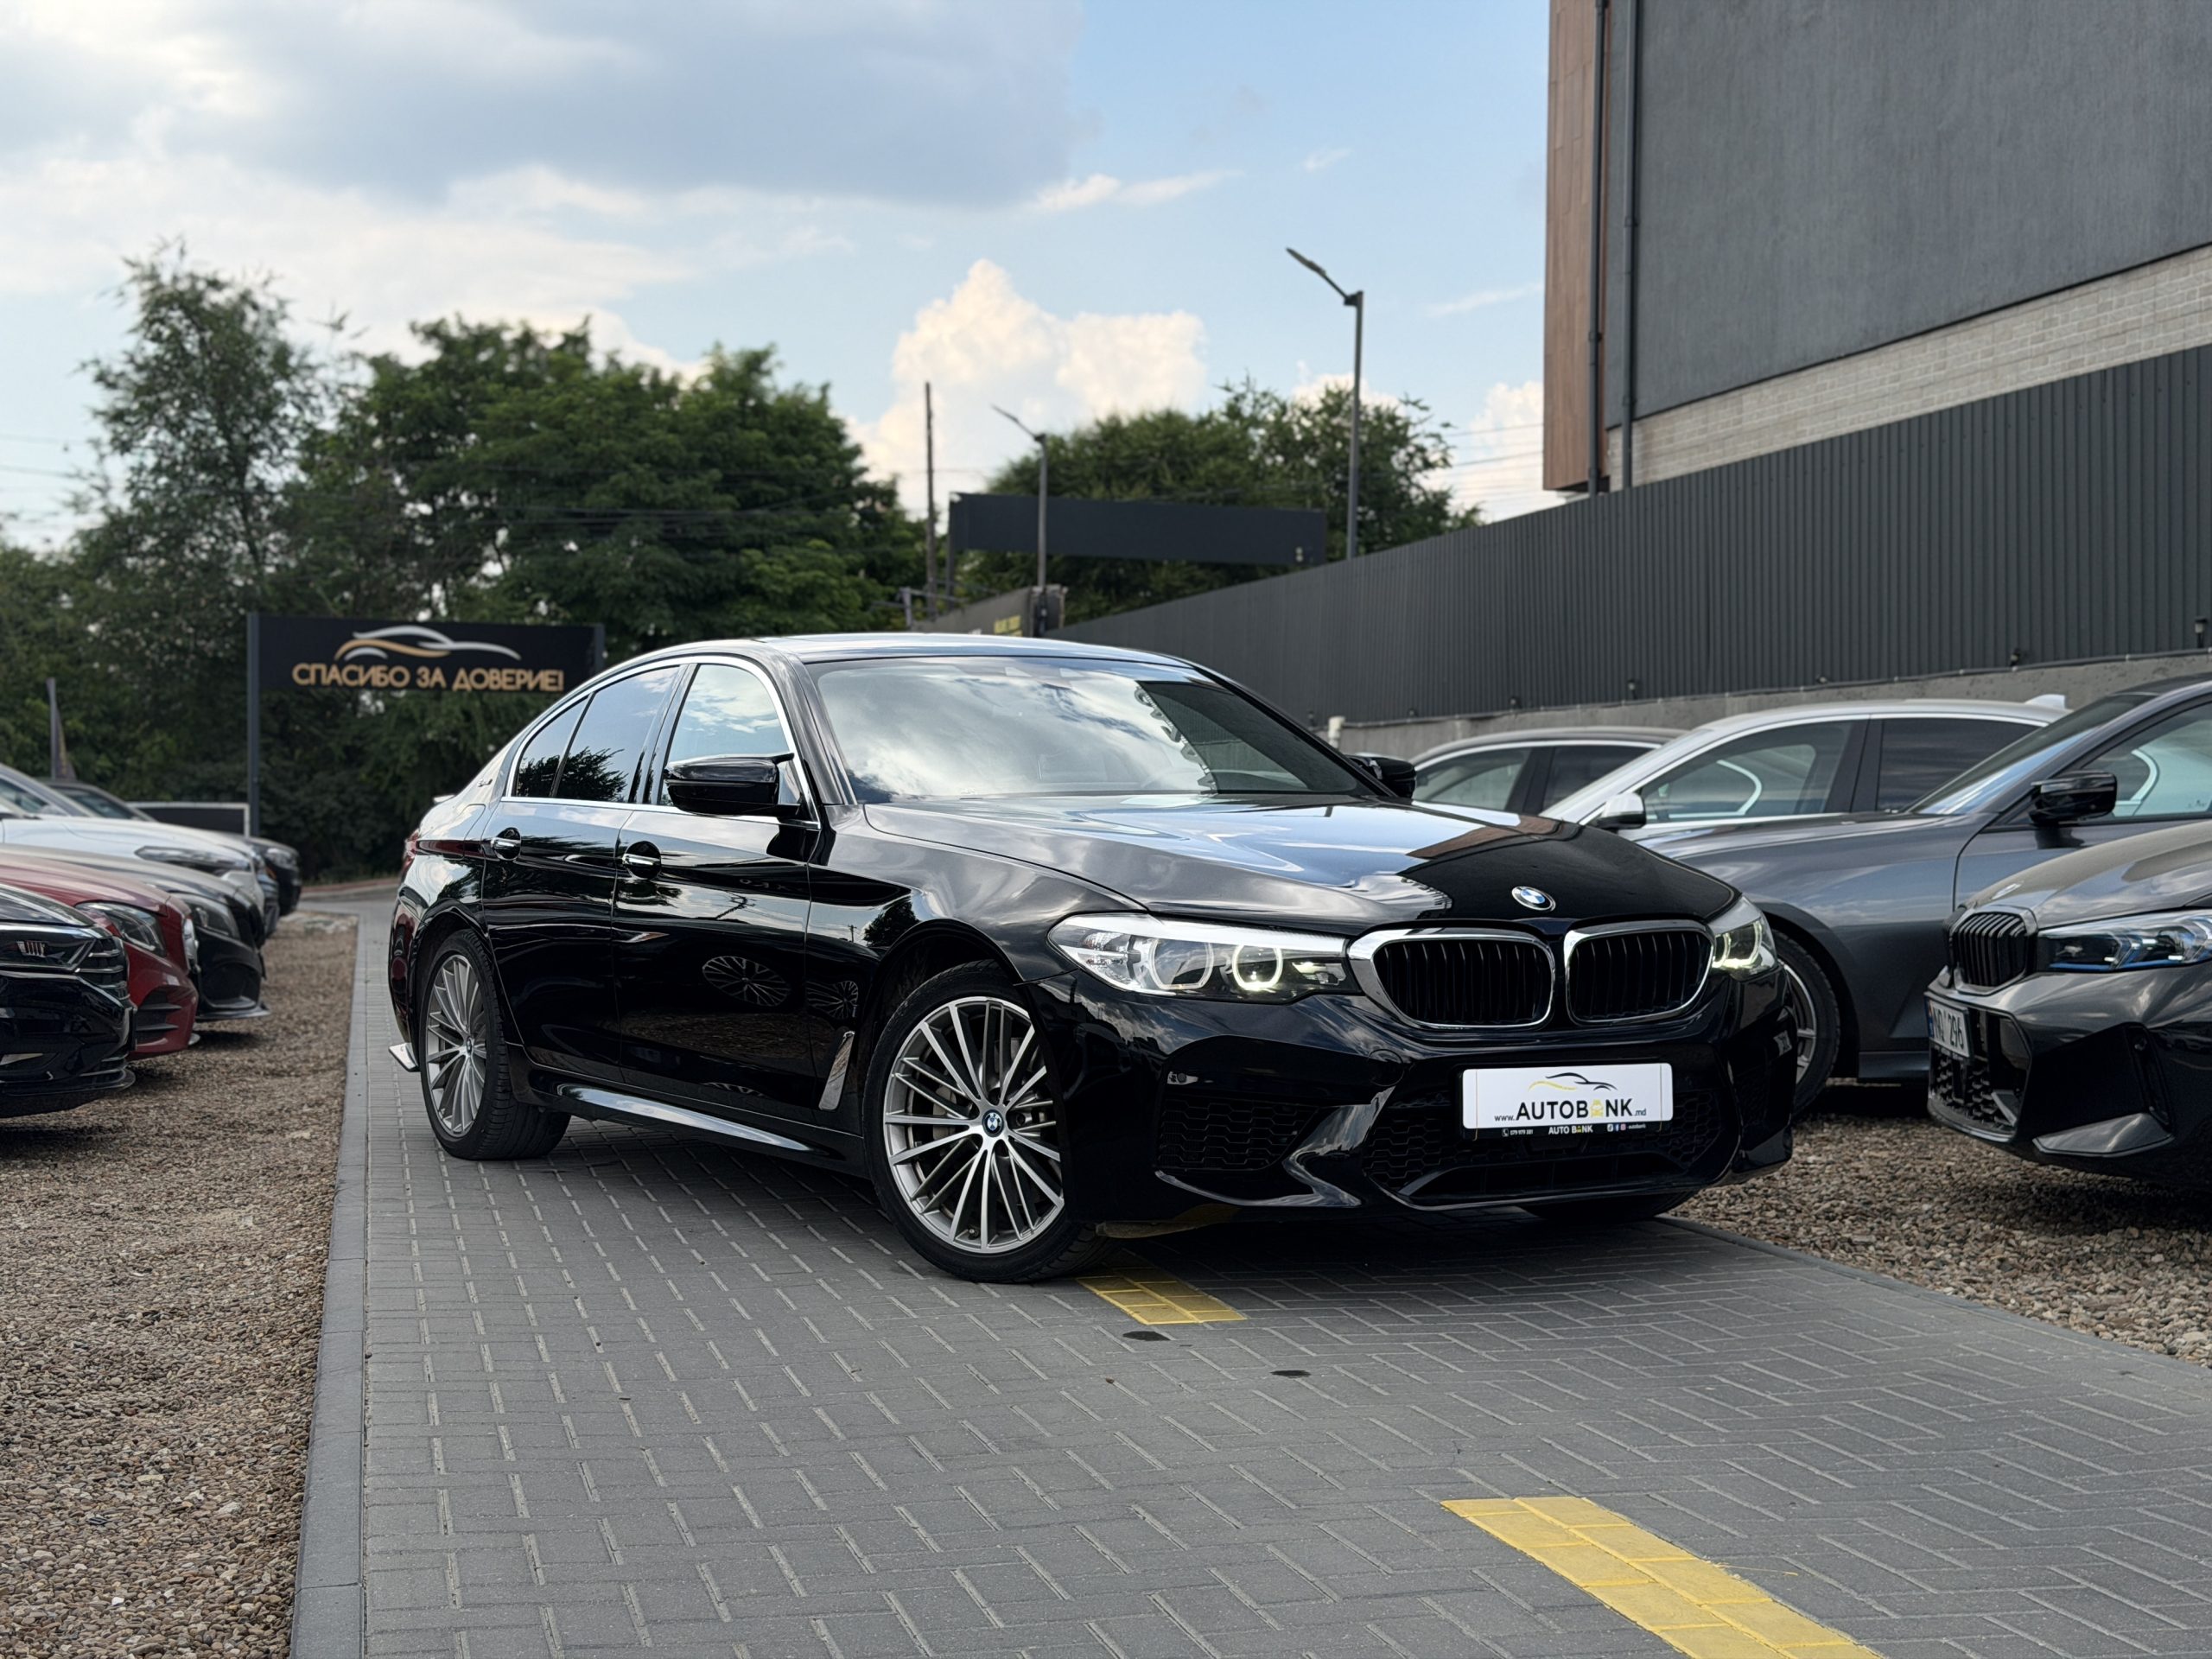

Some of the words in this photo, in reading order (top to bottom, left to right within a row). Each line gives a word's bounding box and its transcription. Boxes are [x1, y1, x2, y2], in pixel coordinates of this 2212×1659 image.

[292, 663, 410, 689] СПАСИБО
[416, 666, 446, 690] ЗА
[452, 668, 564, 692] ДОВЕРИЕ!
[1548, 1126, 1570, 1135] AUTO
